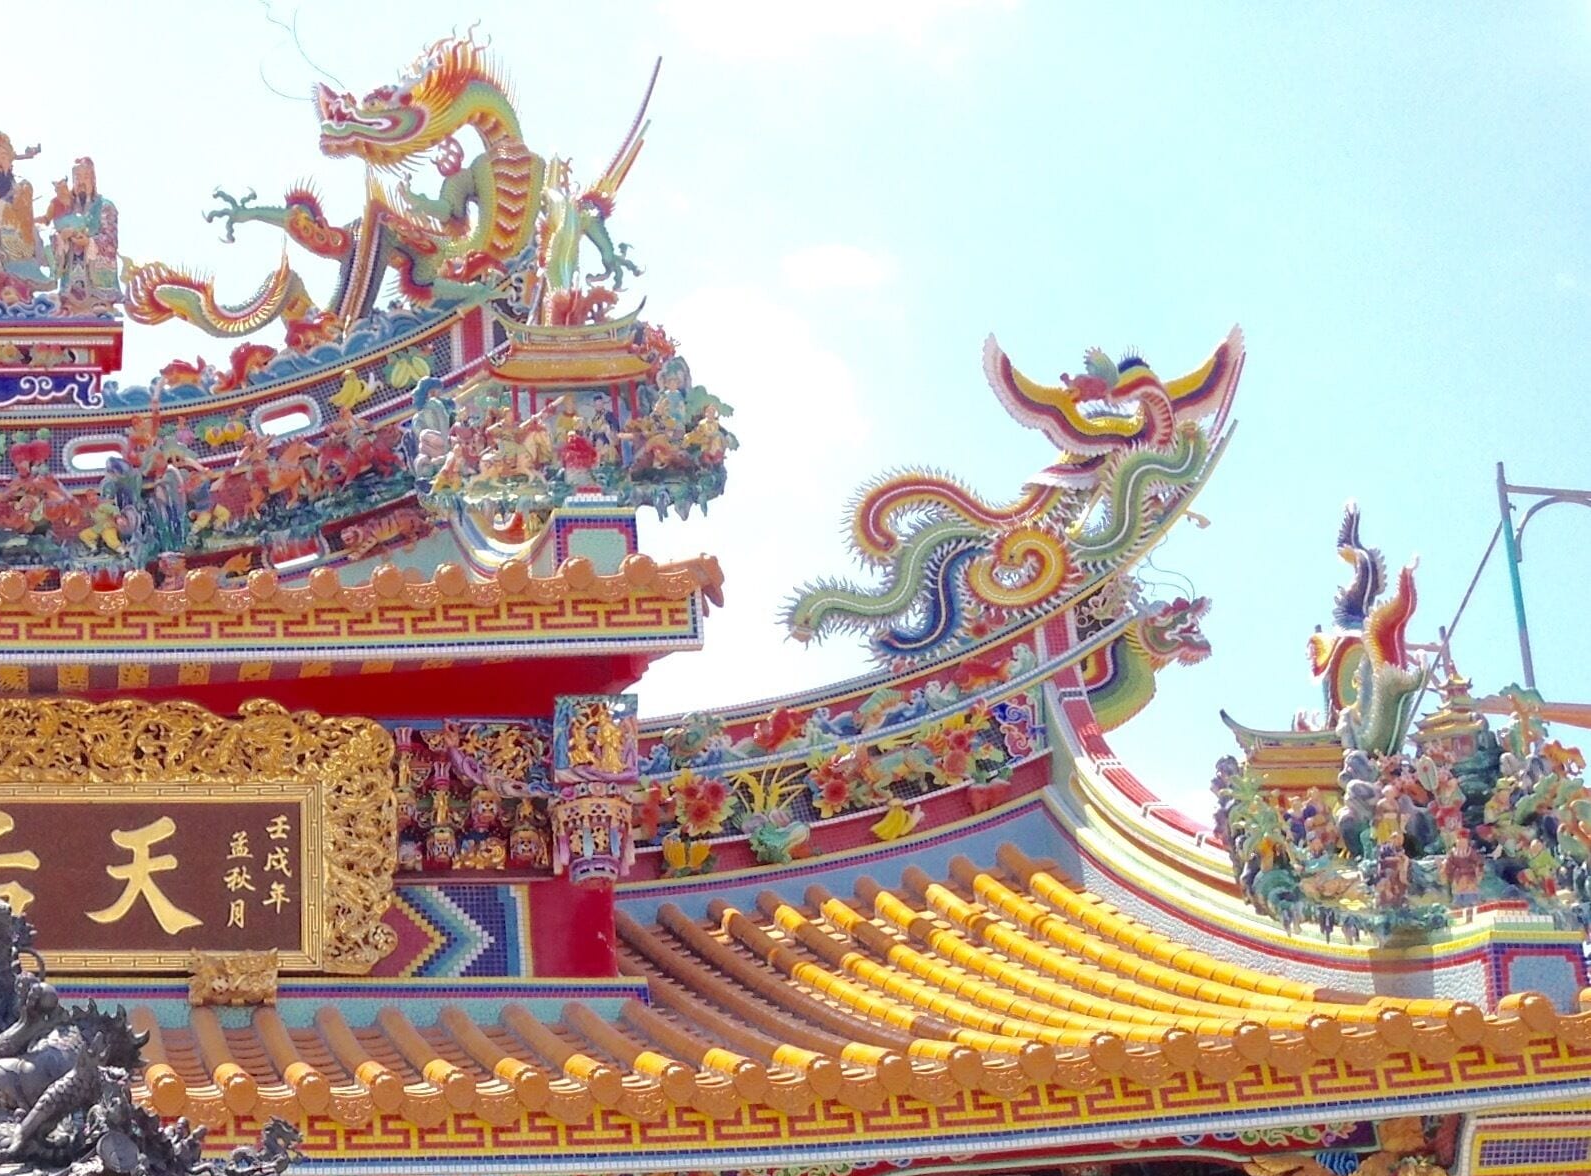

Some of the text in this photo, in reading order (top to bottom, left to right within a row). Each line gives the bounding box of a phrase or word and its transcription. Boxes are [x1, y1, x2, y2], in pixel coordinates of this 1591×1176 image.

[224, 830, 255, 929] 孟秋月
[263, 815, 292, 914] 壬戌年
